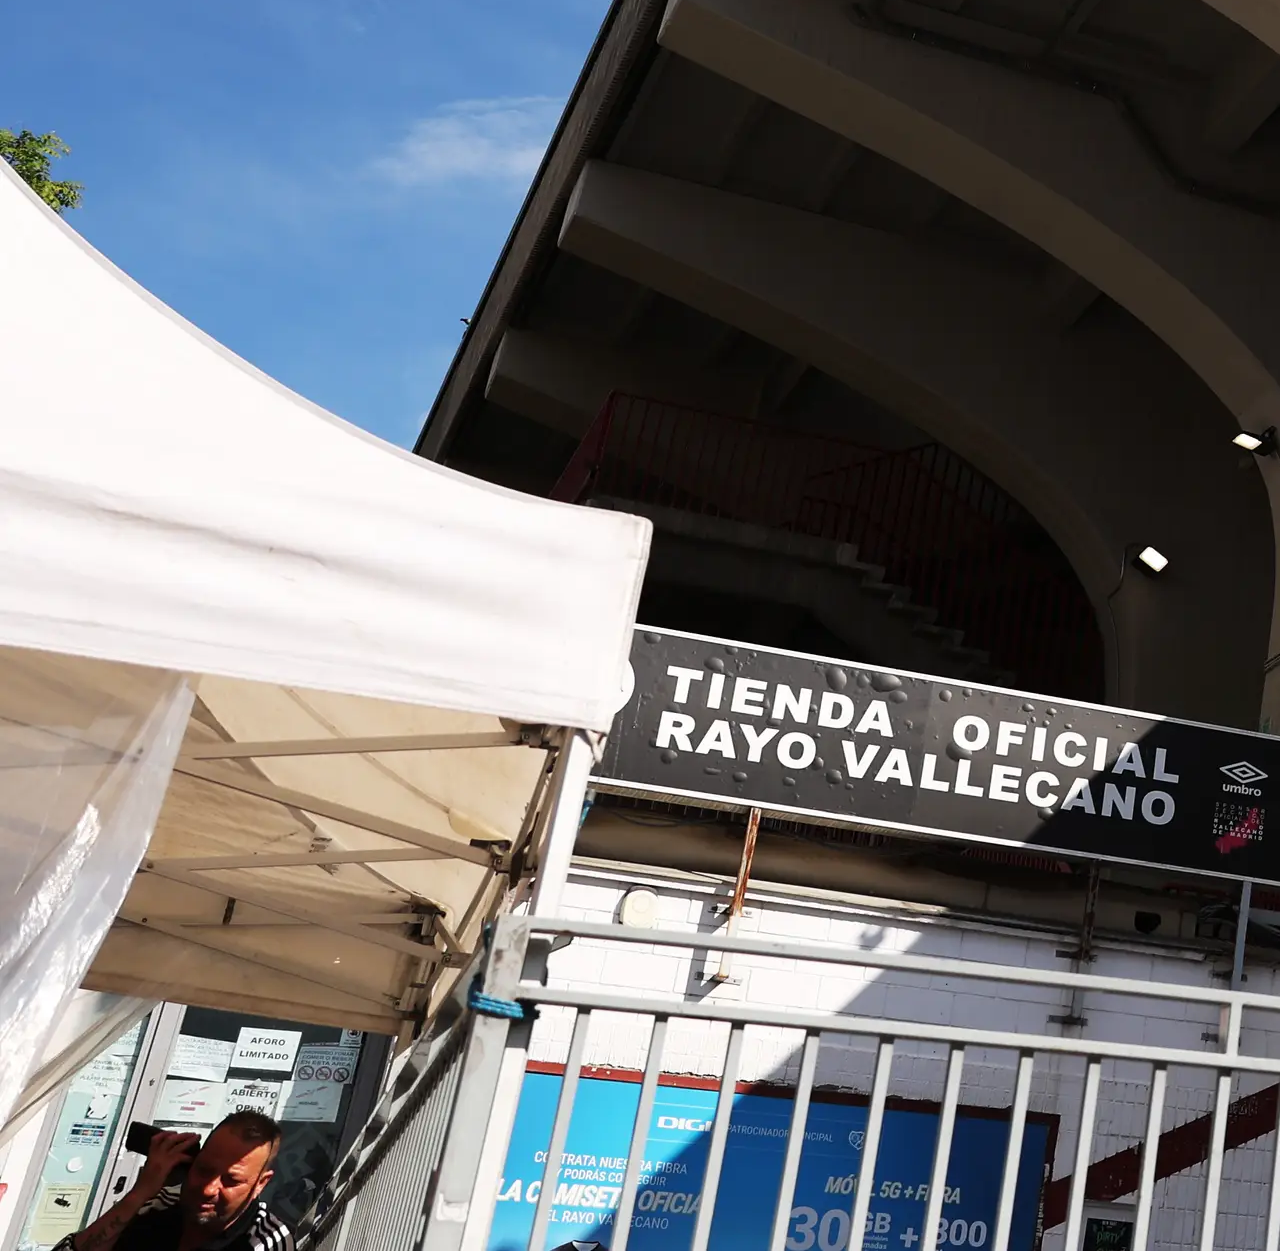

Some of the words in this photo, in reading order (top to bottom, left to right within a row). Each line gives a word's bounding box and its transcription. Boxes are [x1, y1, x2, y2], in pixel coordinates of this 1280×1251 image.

[666, 665, 895, 738] TIENDA
[952, 715, 1180, 784] OFICIAL
[655, 710, 816, 770] RAYO
[841, 739, 1176, 825] VALLECANO
[1222, 783, 1262, 797] umbro
[1213, 824, 1264, 836] VALLECANO
[1230, 831, 1263, 841] MADRID
[250, 1036, 286, 1046] AFORO
[239, 1050, 289, 1061] LIMITADO
[230, 1088, 278, 1099] ABIERTO
[235, 1103, 265, 1113] OPEN
[657, 1116, 713, 1131] DIGI
[804, 1131, 834, 1143] NCIPAL
[534, 1151, 596, 1167] CTRATA
[600, 1157, 652, 1172] NUESRA
[655, 1161, 687, 1175] FIBRA
[563, 1167, 606, 1182] PODRÁS
[608, 1171, 667, 1186] COEGUIR
[496, 1178, 521, 1202] LA
[526, 1181, 622, 1209] CMISET
[637, 1190, 703, 1214] OFICIA
[915, 1183, 960, 1205] FIRA
[561, 1210, 595, 1225] RAYO
[598, 1212, 669, 1230] VAECANO
